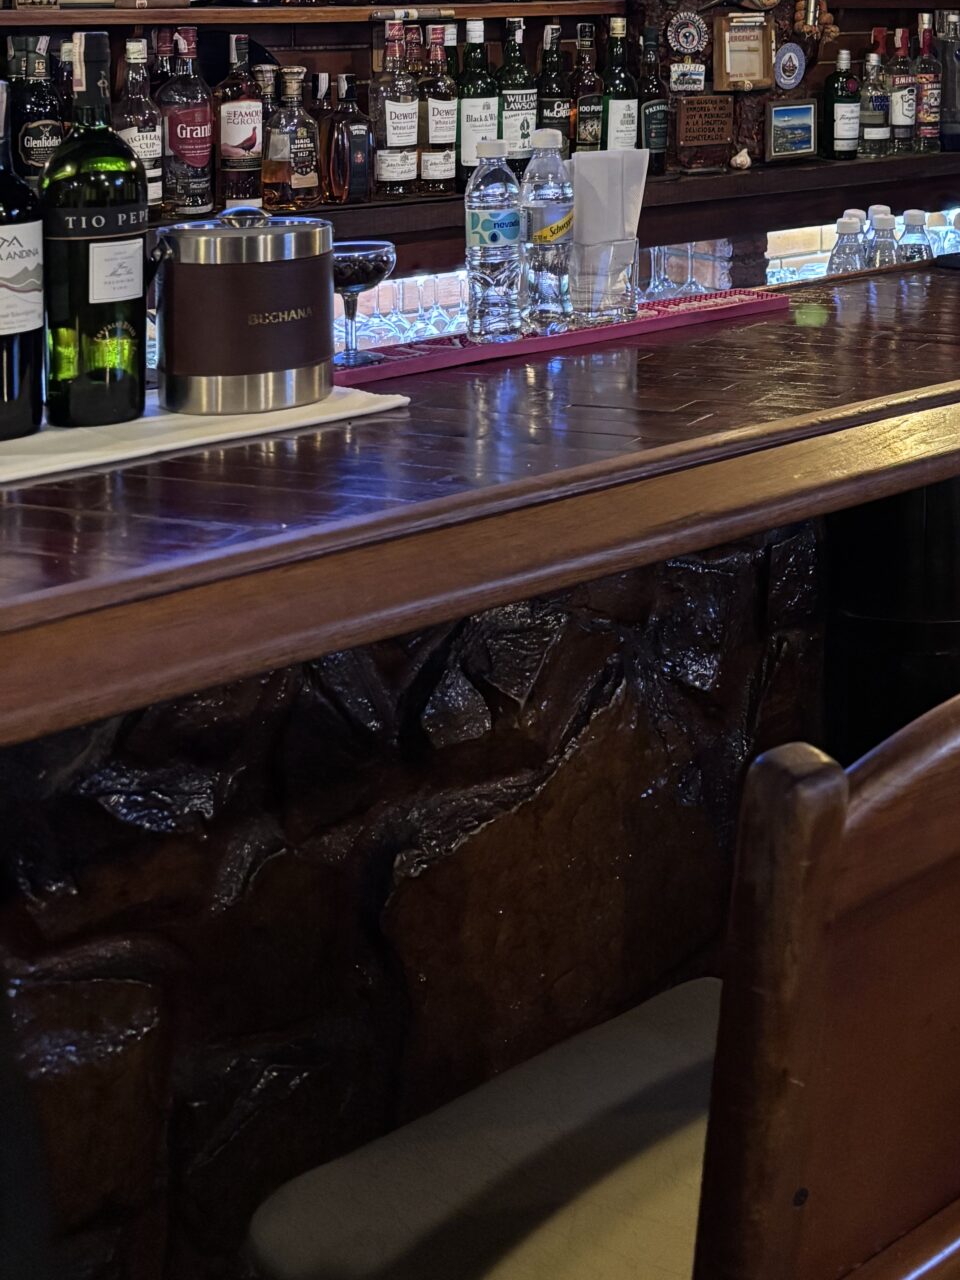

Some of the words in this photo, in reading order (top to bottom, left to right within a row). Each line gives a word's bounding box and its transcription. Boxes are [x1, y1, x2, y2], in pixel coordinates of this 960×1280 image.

[670, 64, 705, 72] MADRID
[466, 114, 483, 123] Black
[140, 139, 156, 149] CUP
[65, 215, 106, 229] TIO
[6, 248, 39, 261] ANDINA
